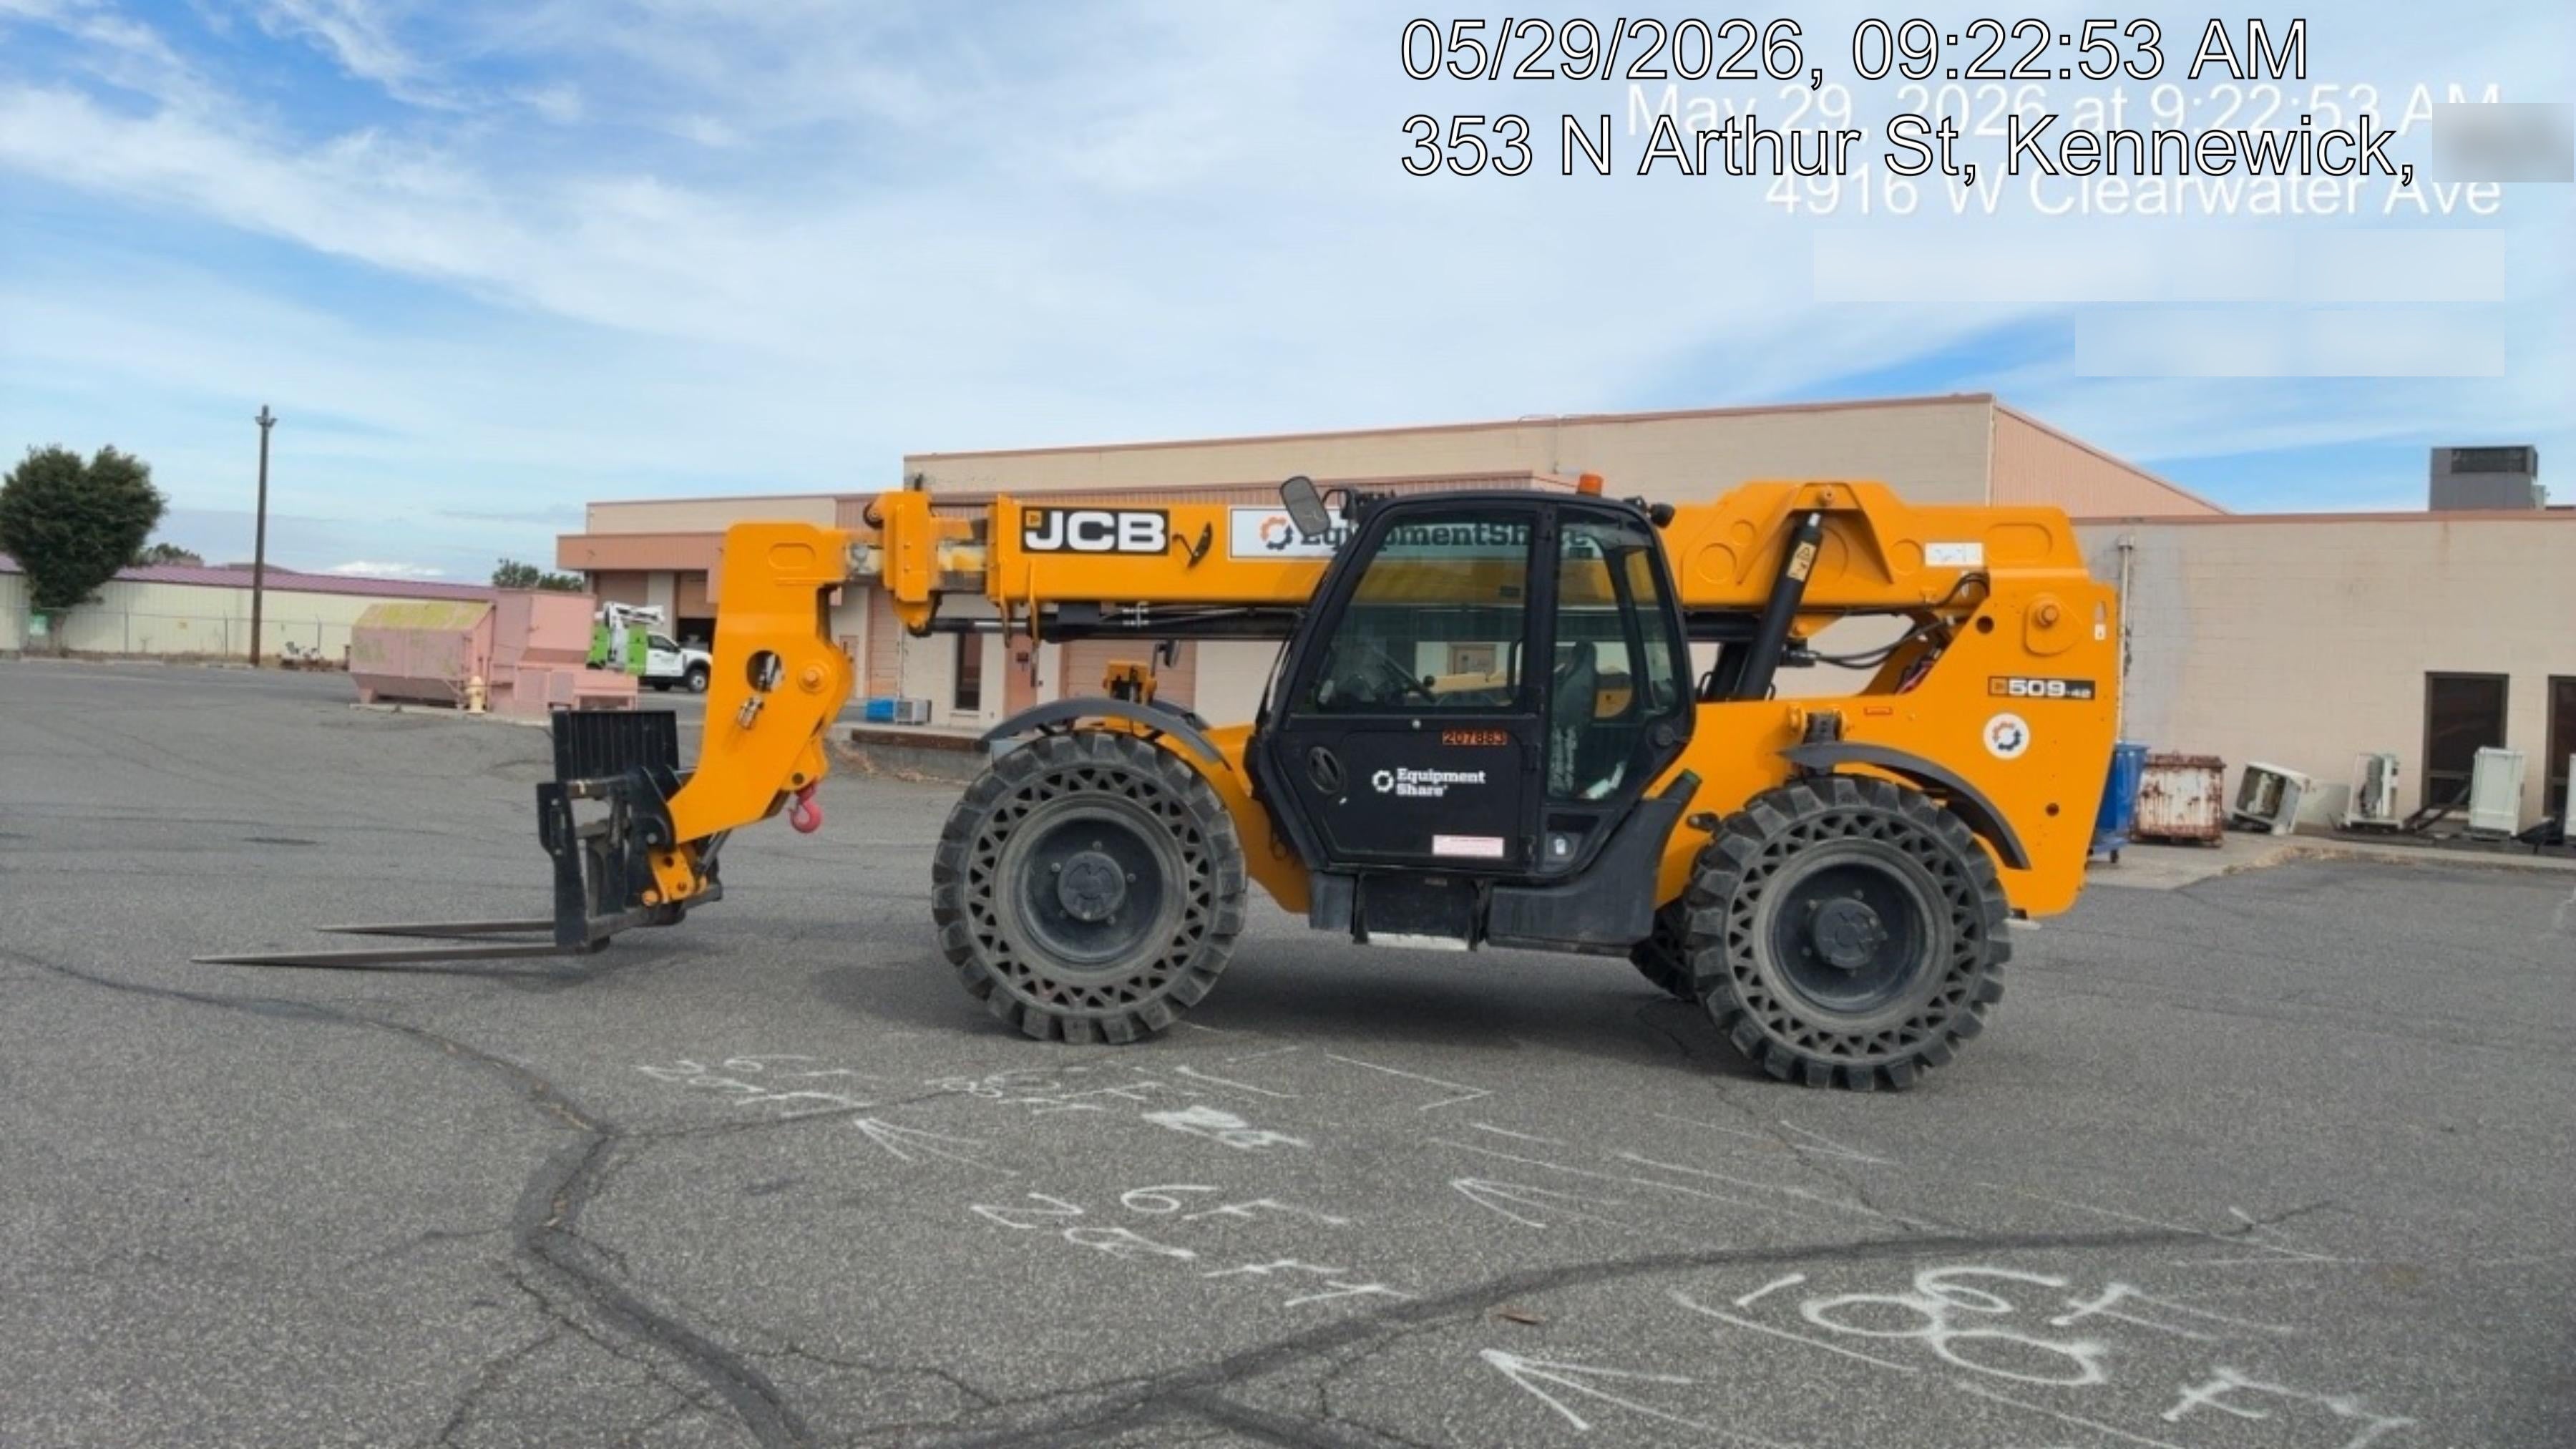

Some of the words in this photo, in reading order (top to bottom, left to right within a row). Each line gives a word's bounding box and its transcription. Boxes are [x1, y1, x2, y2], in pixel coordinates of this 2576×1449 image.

[1025, 511, 1165, 551] JCB
[1396, 767, 1486, 785] Equipment
[1396, 783, 1444, 797] Share
